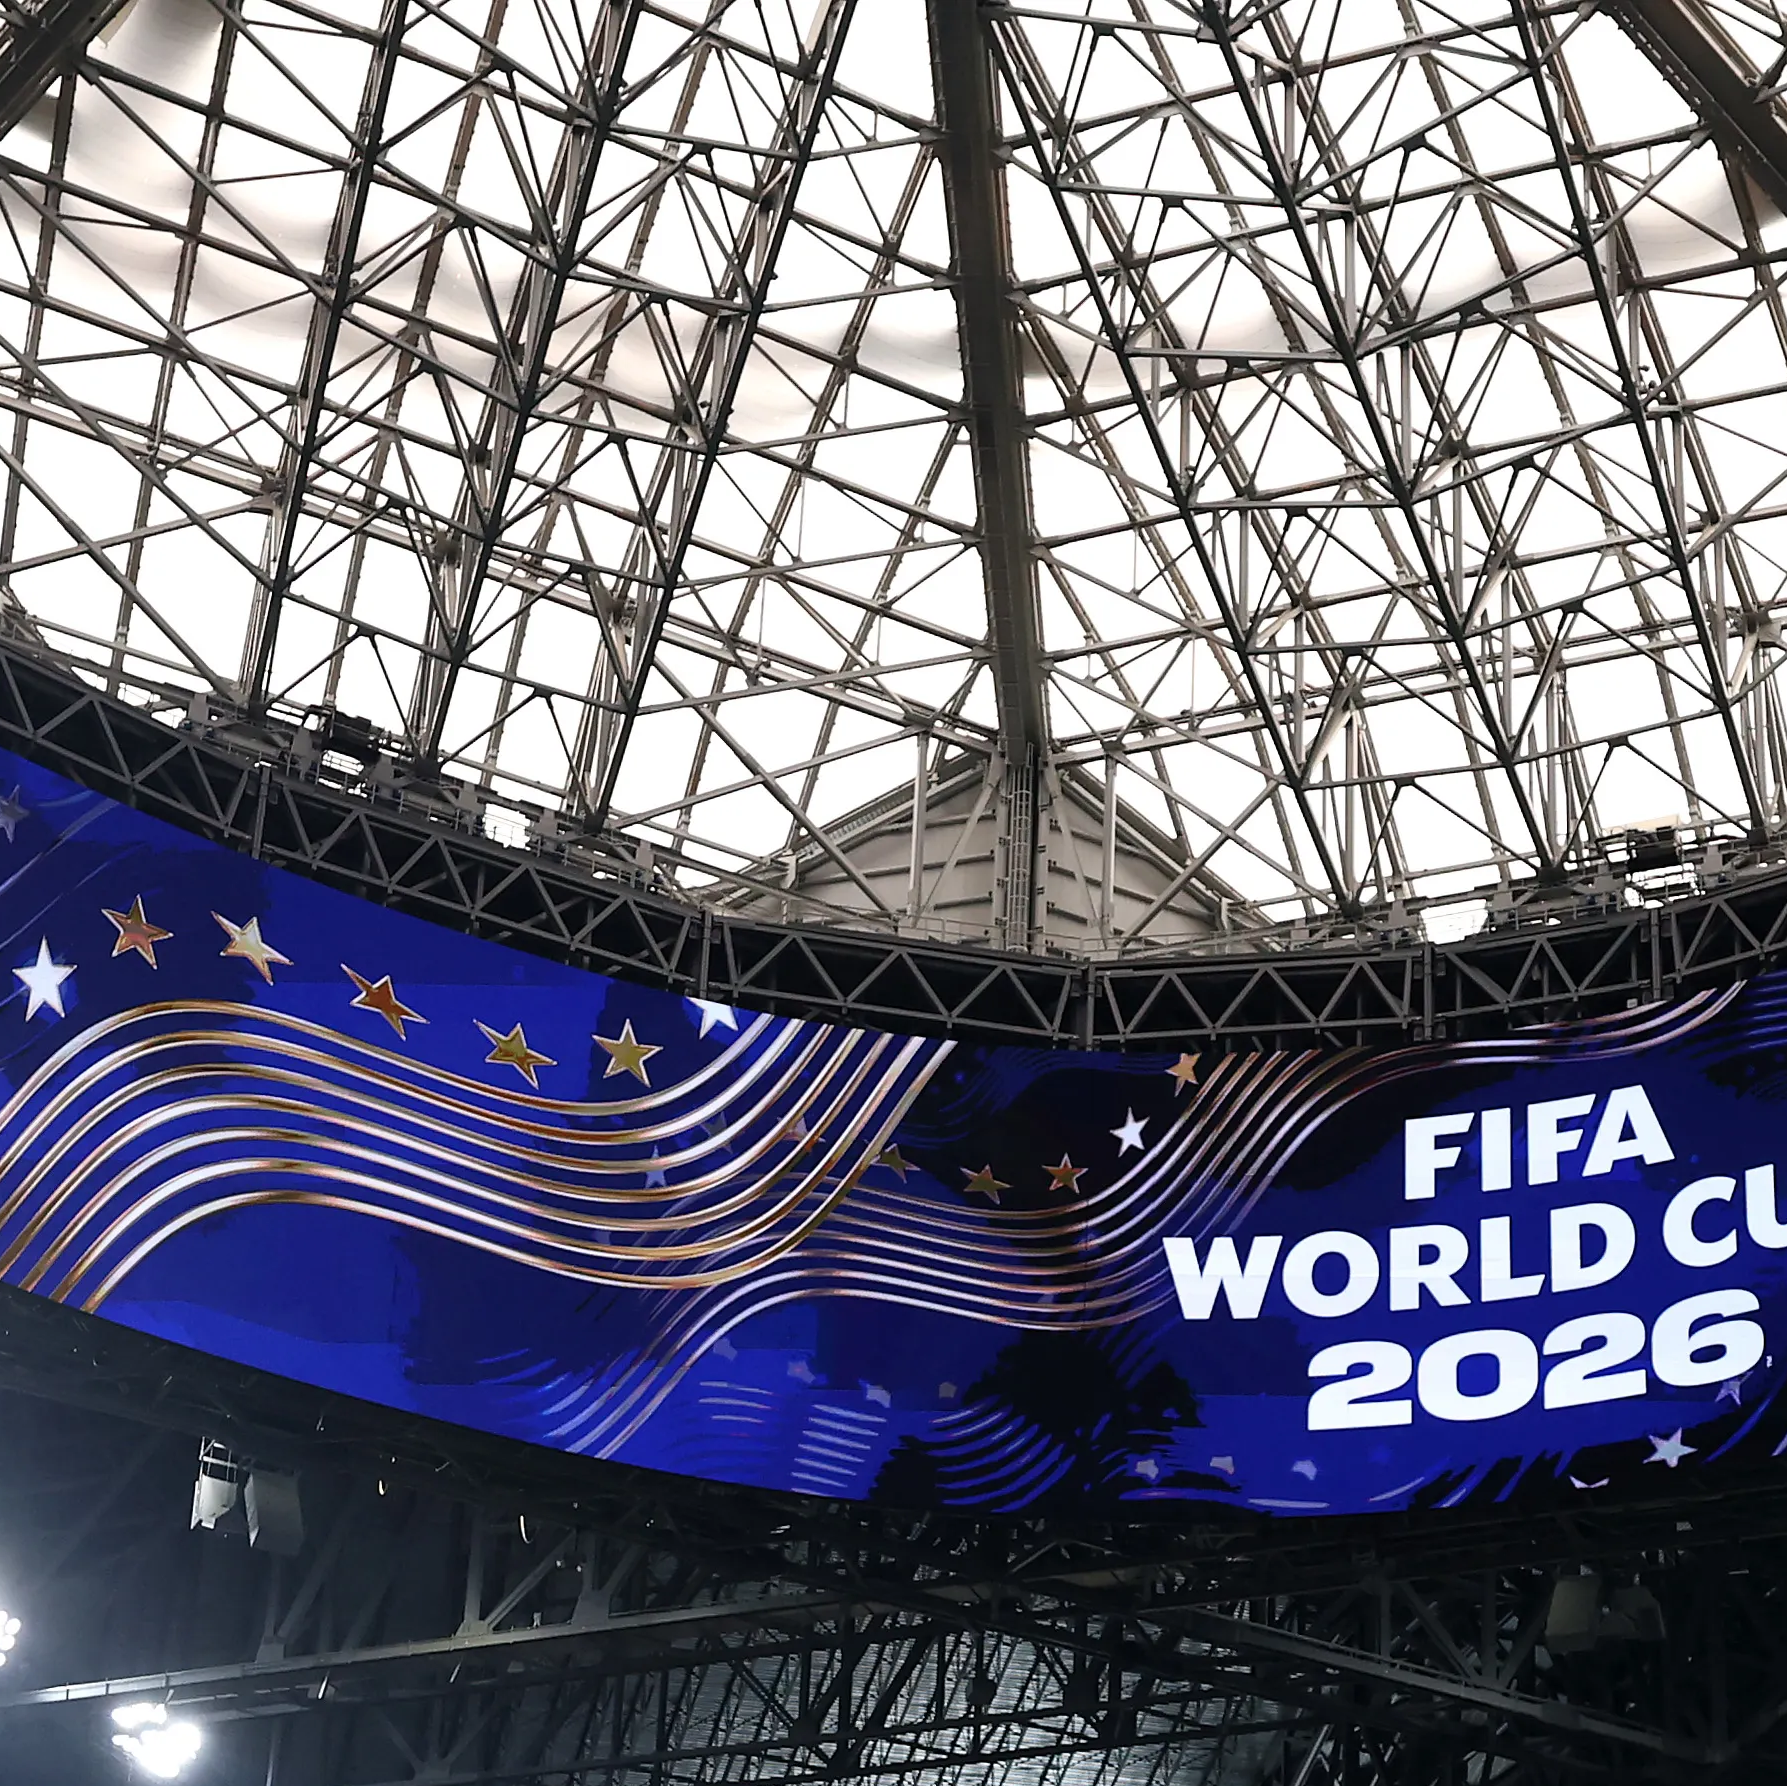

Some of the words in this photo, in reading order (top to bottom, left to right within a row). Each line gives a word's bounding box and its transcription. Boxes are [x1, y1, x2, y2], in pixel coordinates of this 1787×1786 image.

[1405, 1085, 1676, 1201] FIFA
[1160, 1201, 1638, 1322] WORLD
[1305, 1287, 1764, 1432] 2026
